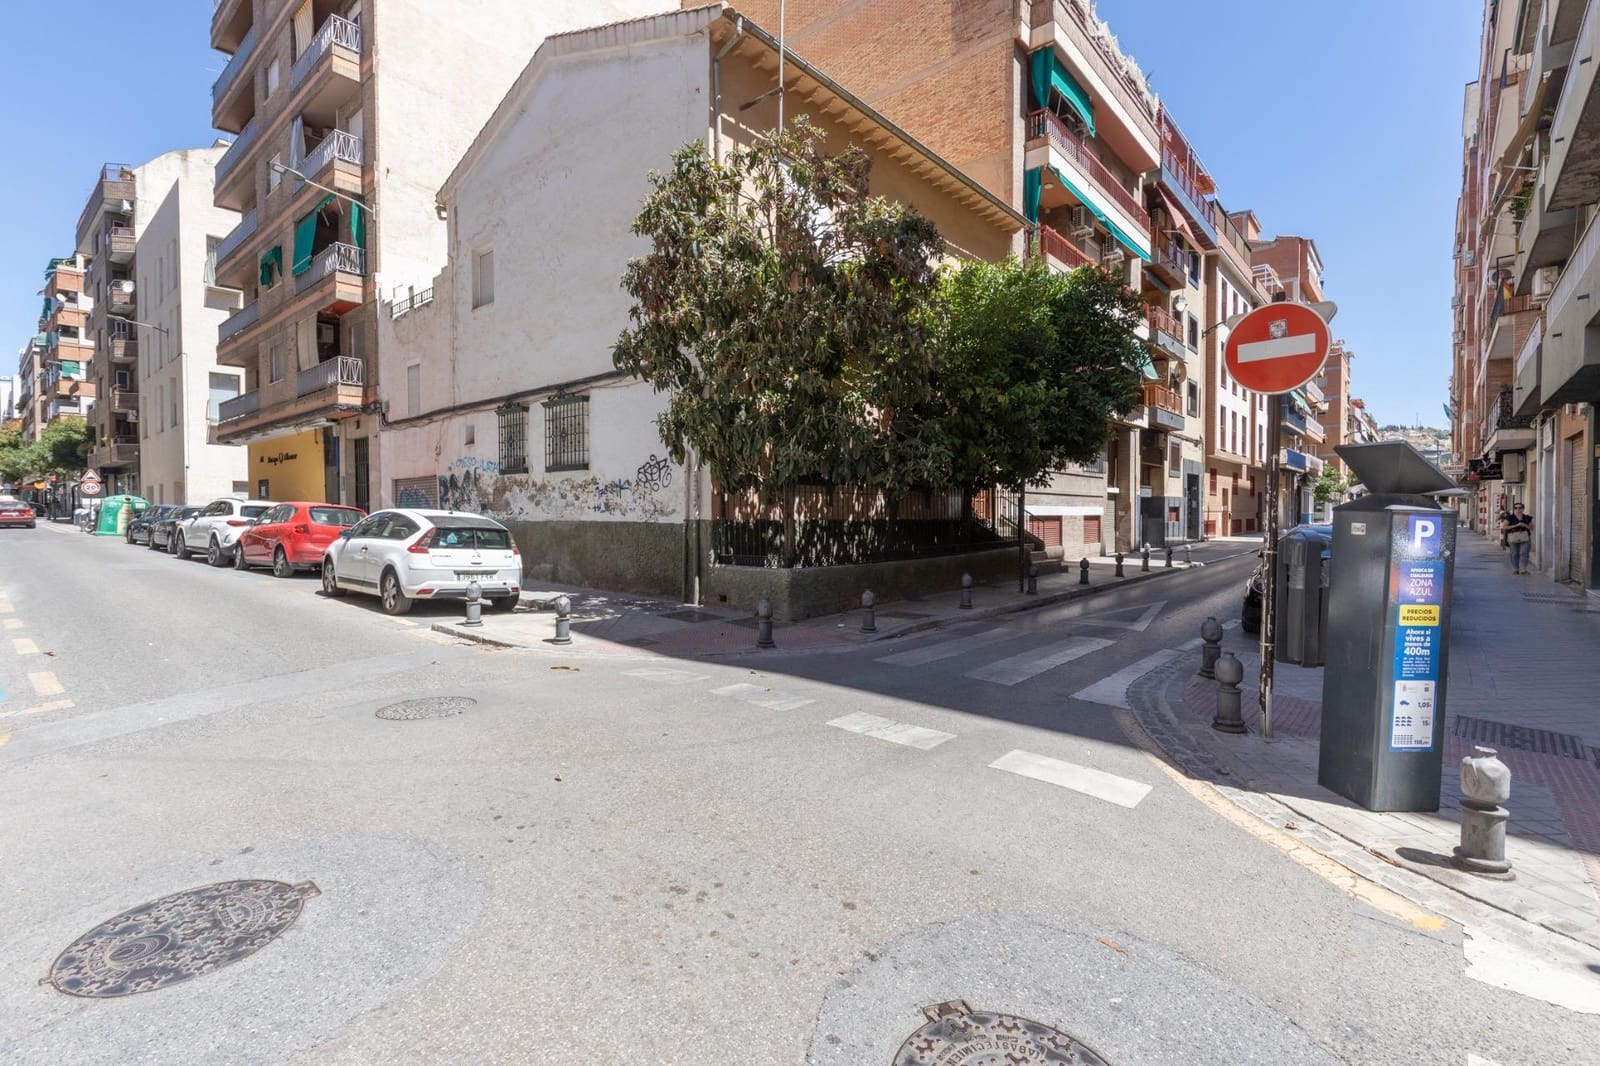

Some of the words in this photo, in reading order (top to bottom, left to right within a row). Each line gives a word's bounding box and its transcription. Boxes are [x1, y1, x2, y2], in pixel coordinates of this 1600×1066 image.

[1414, 520, 1435, 548] P
[1410, 579, 1433, 587] ZONA
[1409, 588, 1432, 596] AZUL
[1404, 647, 1430, 655] 400m
[944, 1041, 1038, 1066] ABASTECIMIEN
